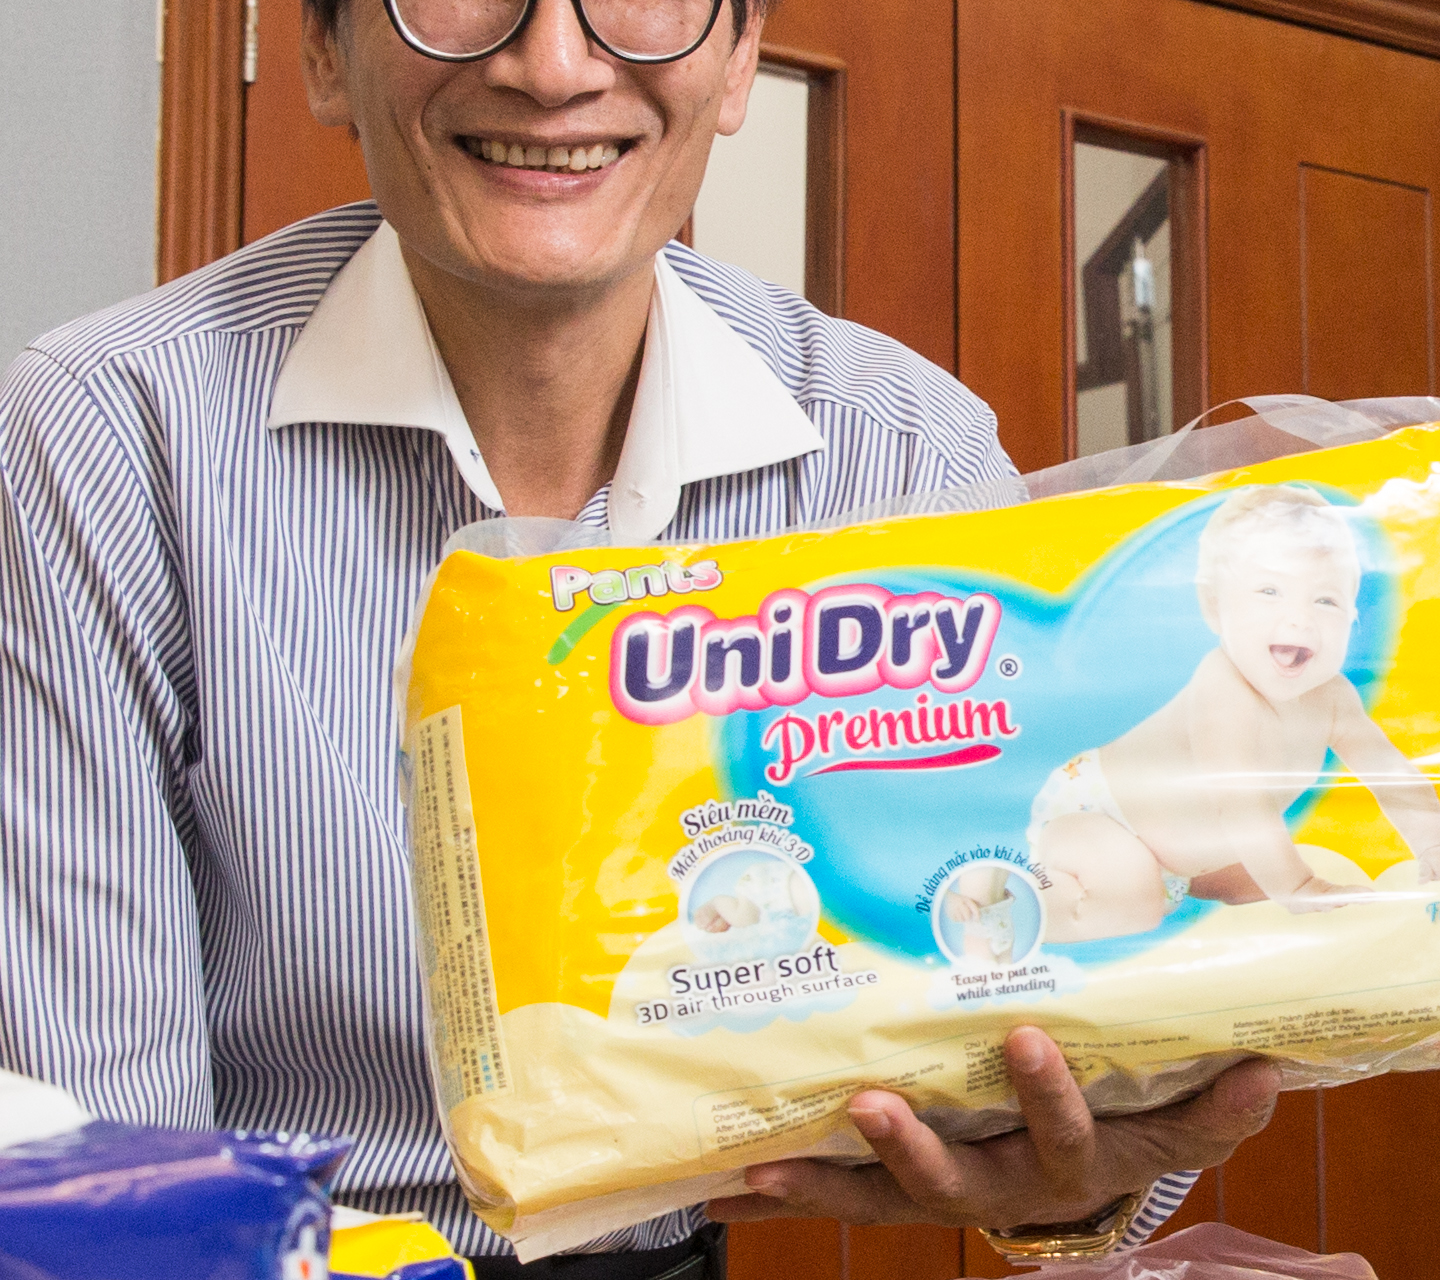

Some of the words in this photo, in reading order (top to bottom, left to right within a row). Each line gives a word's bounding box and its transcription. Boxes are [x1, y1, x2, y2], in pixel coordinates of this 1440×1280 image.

[550, 558, 724, 611] Pants
[612, 586, 1000, 720] UniDry
[762, 692, 1019, 786] Premium
[682, 801, 734, 837] Siêu
[735, 790, 792, 827] mềm
[697, 827, 755, 856] thoáng
[637, 1001, 670, 1025] 3D
[674, 995, 709, 1020] air
[711, 980, 798, 1017] through
[800, 967, 880, 997] surface
[670, 958, 766, 1000] Super
[777, 945, 840, 980] soft
[950, 970, 989, 990] Easy
[990, 969, 1005, 983] to
[1006, 965, 1029, 985] put
[1030, 963, 1051, 977] on
[955, 986, 993, 1003] while
[994, 974, 1058, 999] standing
